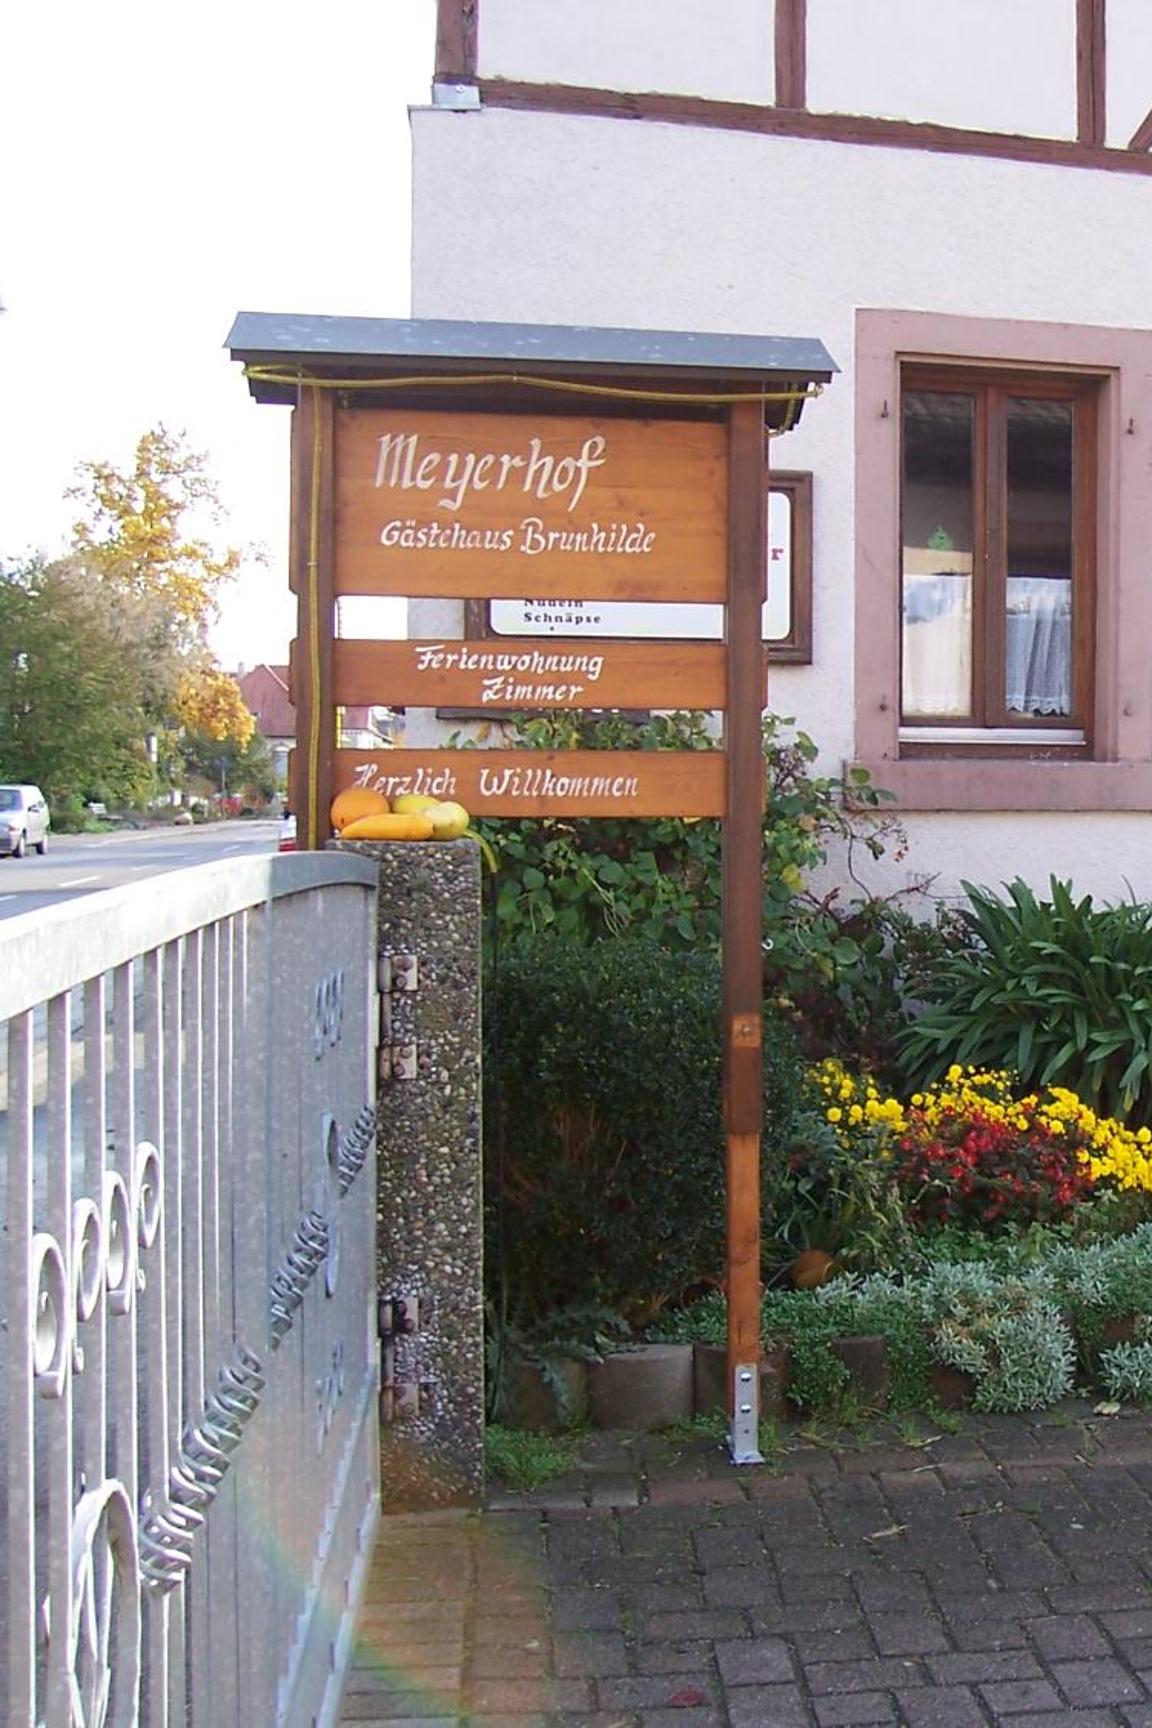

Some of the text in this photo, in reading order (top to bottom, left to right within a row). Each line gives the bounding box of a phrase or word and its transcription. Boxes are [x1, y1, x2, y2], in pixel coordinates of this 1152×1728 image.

[374, 433, 606, 511] Meyerhof
[380, 516, 656, 554] Gästehaus Brunhilde
[523, 612, 602, 625] Schnäpse
[416, 645, 604, 680] Ferienwohnung
[481, 677, 584, 702] Zimmer
[352, 762, 639, 798] Herzlich Willkommen
